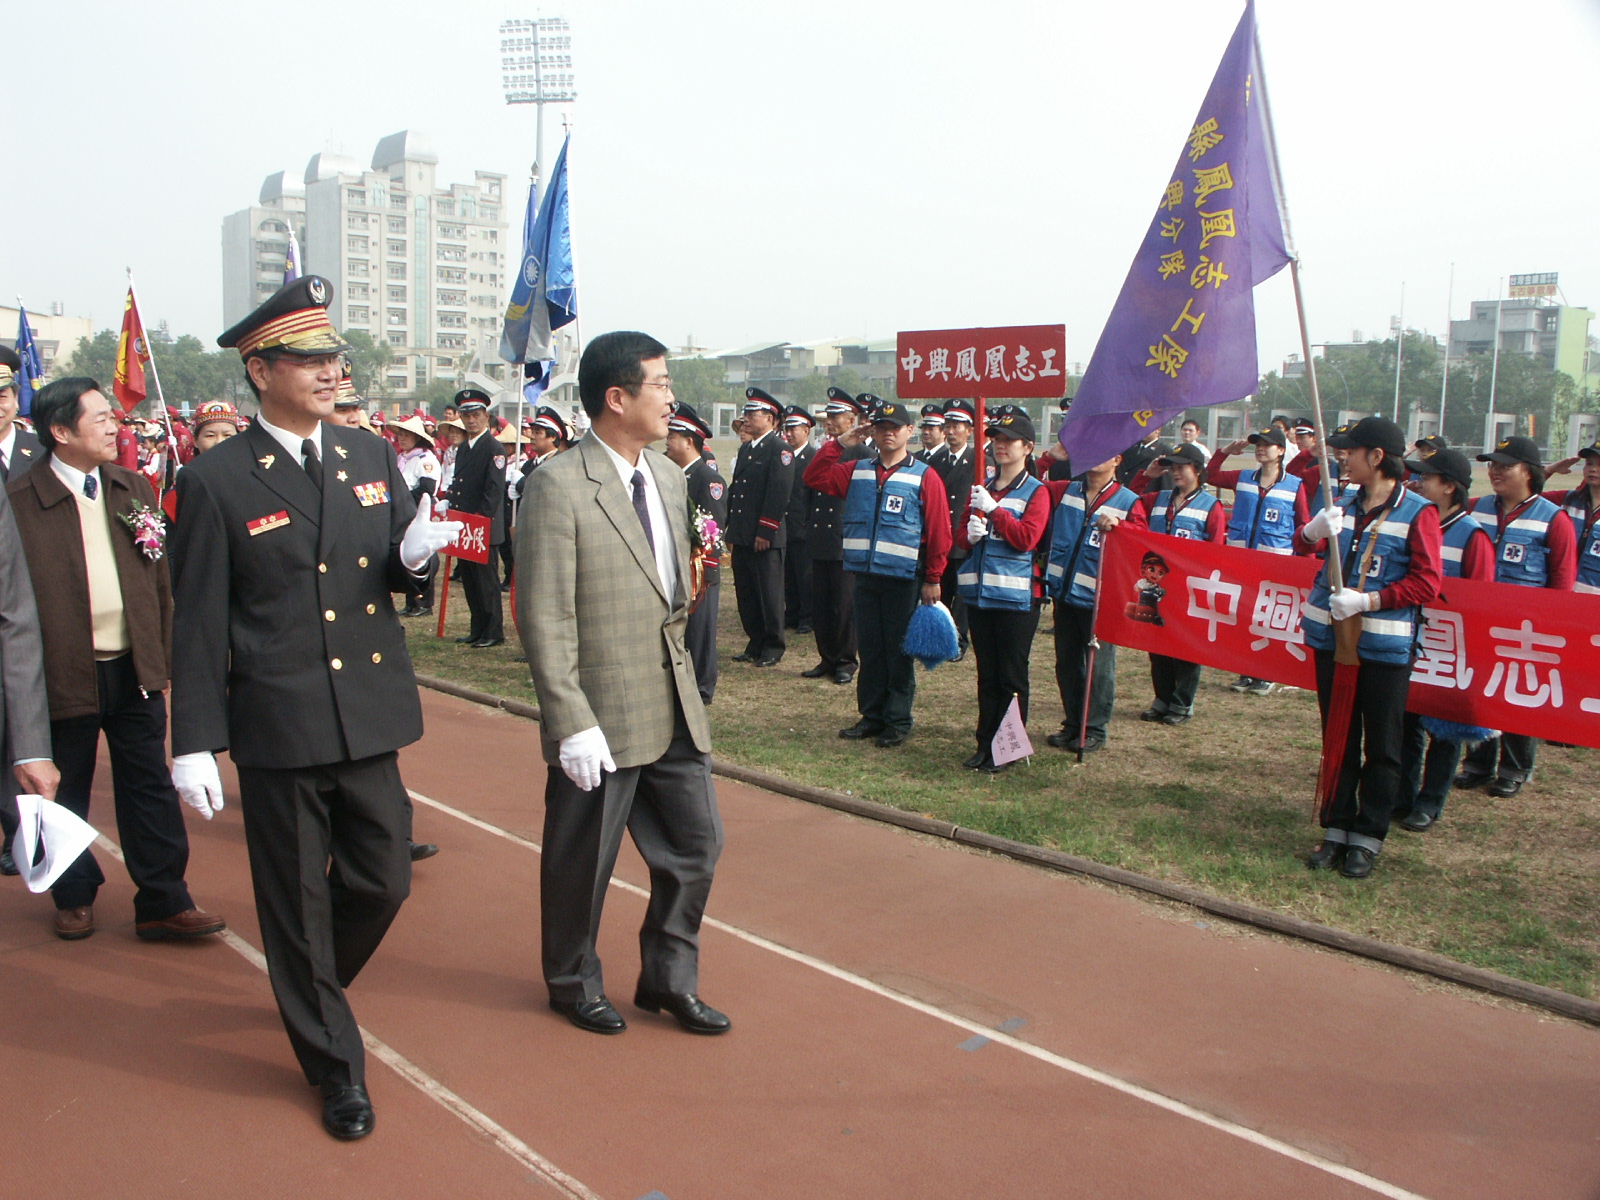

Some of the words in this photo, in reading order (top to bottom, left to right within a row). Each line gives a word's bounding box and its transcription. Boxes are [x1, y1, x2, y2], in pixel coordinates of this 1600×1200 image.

[901, 345, 1061, 383] 中興鳳凰志工
